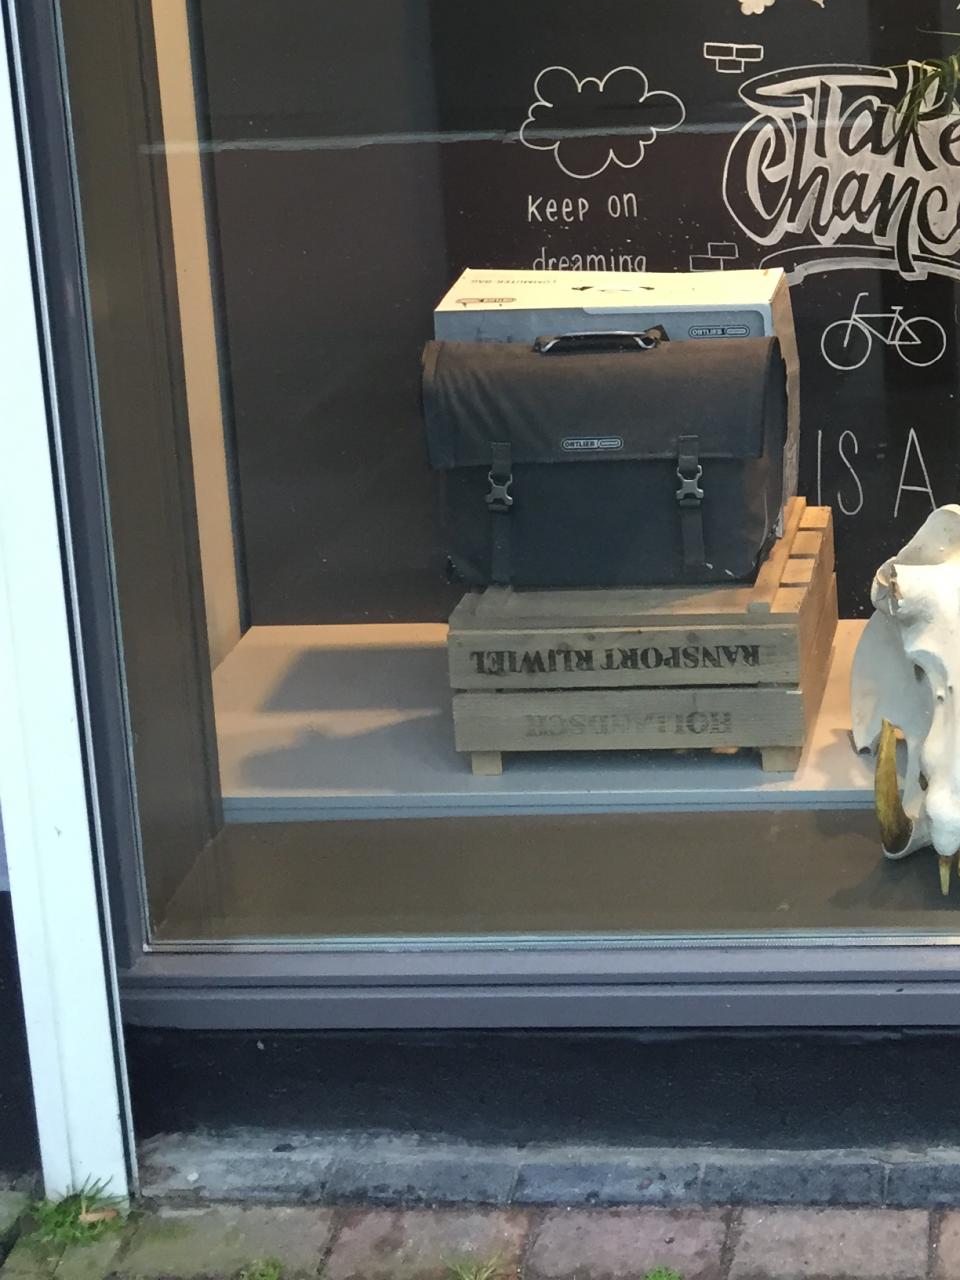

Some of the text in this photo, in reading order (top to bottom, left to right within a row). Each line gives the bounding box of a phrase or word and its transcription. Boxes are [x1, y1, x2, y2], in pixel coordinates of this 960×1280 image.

[607, 192, 638, 218] on
[817, 429, 864, 516] IS
[893, 427, 938, 518] A
